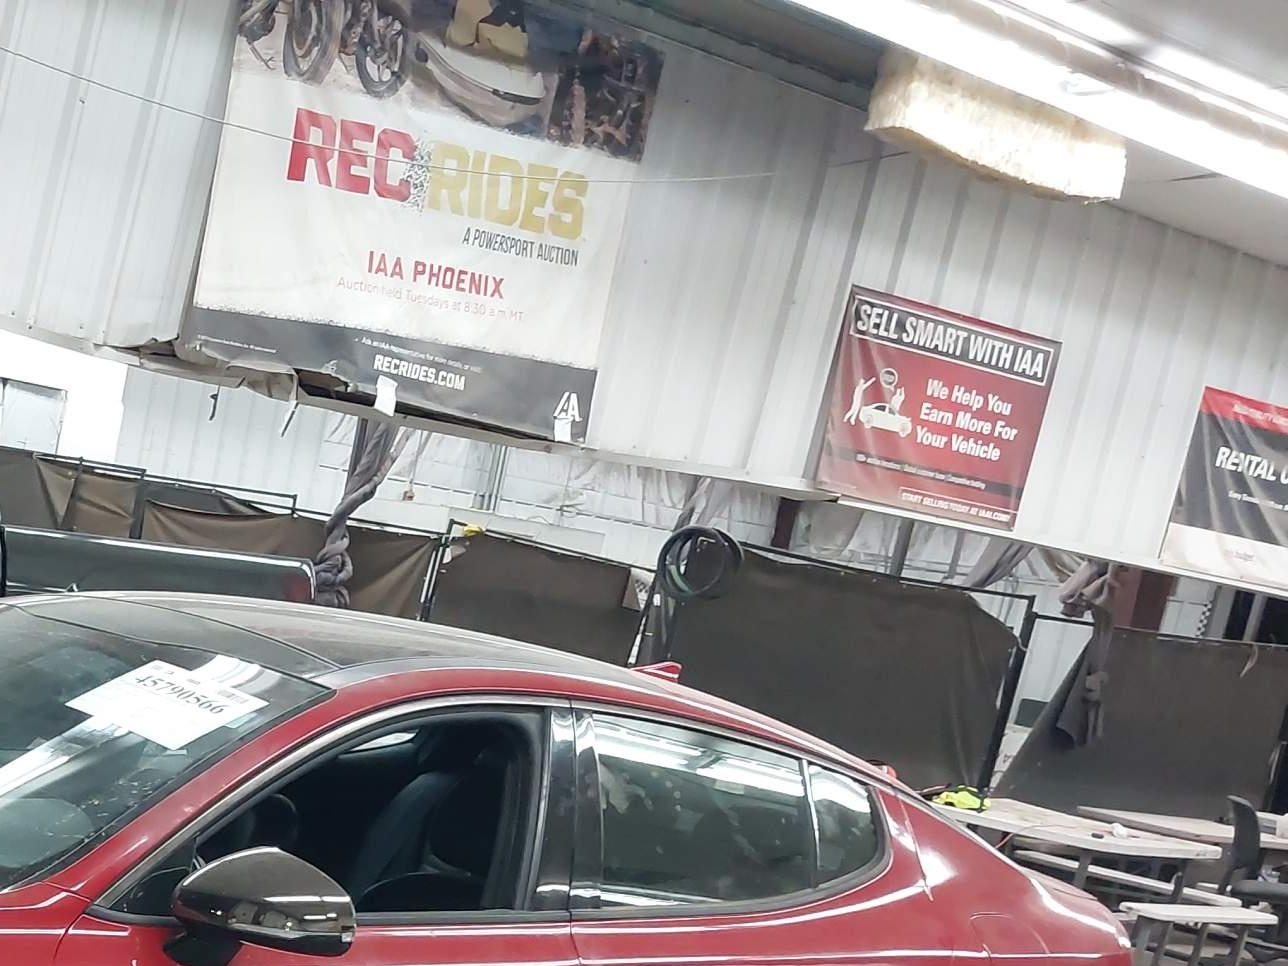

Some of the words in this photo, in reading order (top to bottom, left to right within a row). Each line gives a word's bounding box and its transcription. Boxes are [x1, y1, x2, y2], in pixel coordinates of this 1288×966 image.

[286, 106, 417, 203] REC
[426, 139, 589, 241] RIDES
[462, 226, 471, 245] A
[472, 229, 535, 259] POWERSPORT
[537, 242, 579, 267] AUCTION
[367, 250, 404, 281] IAA
[412, 260, 505, 299] PHOENIX
[856, 304, 898, 340] SELL
[902, 316, 968, 356] SMART
[968, 333, 1014, 370] WITH
[1014, 346, 1044, 379] IAA
[373, 353, 466, 391] RECRIDES.COM
[926, 378, 949, 400] We
[951, 384, 984, 412] Help
[987, 393, 1012, 416] You
[919, 401, 953, 426] Earn
[955, 410, 992, 435] More
[993, 420, 1018, 441] For
[915, 424, 948, 449] Your
[951, 433, 1000, 461] Vehicle
[1215, 446, 1277, 481] RENTAL
[135, 675, 231, 714] 45790566
